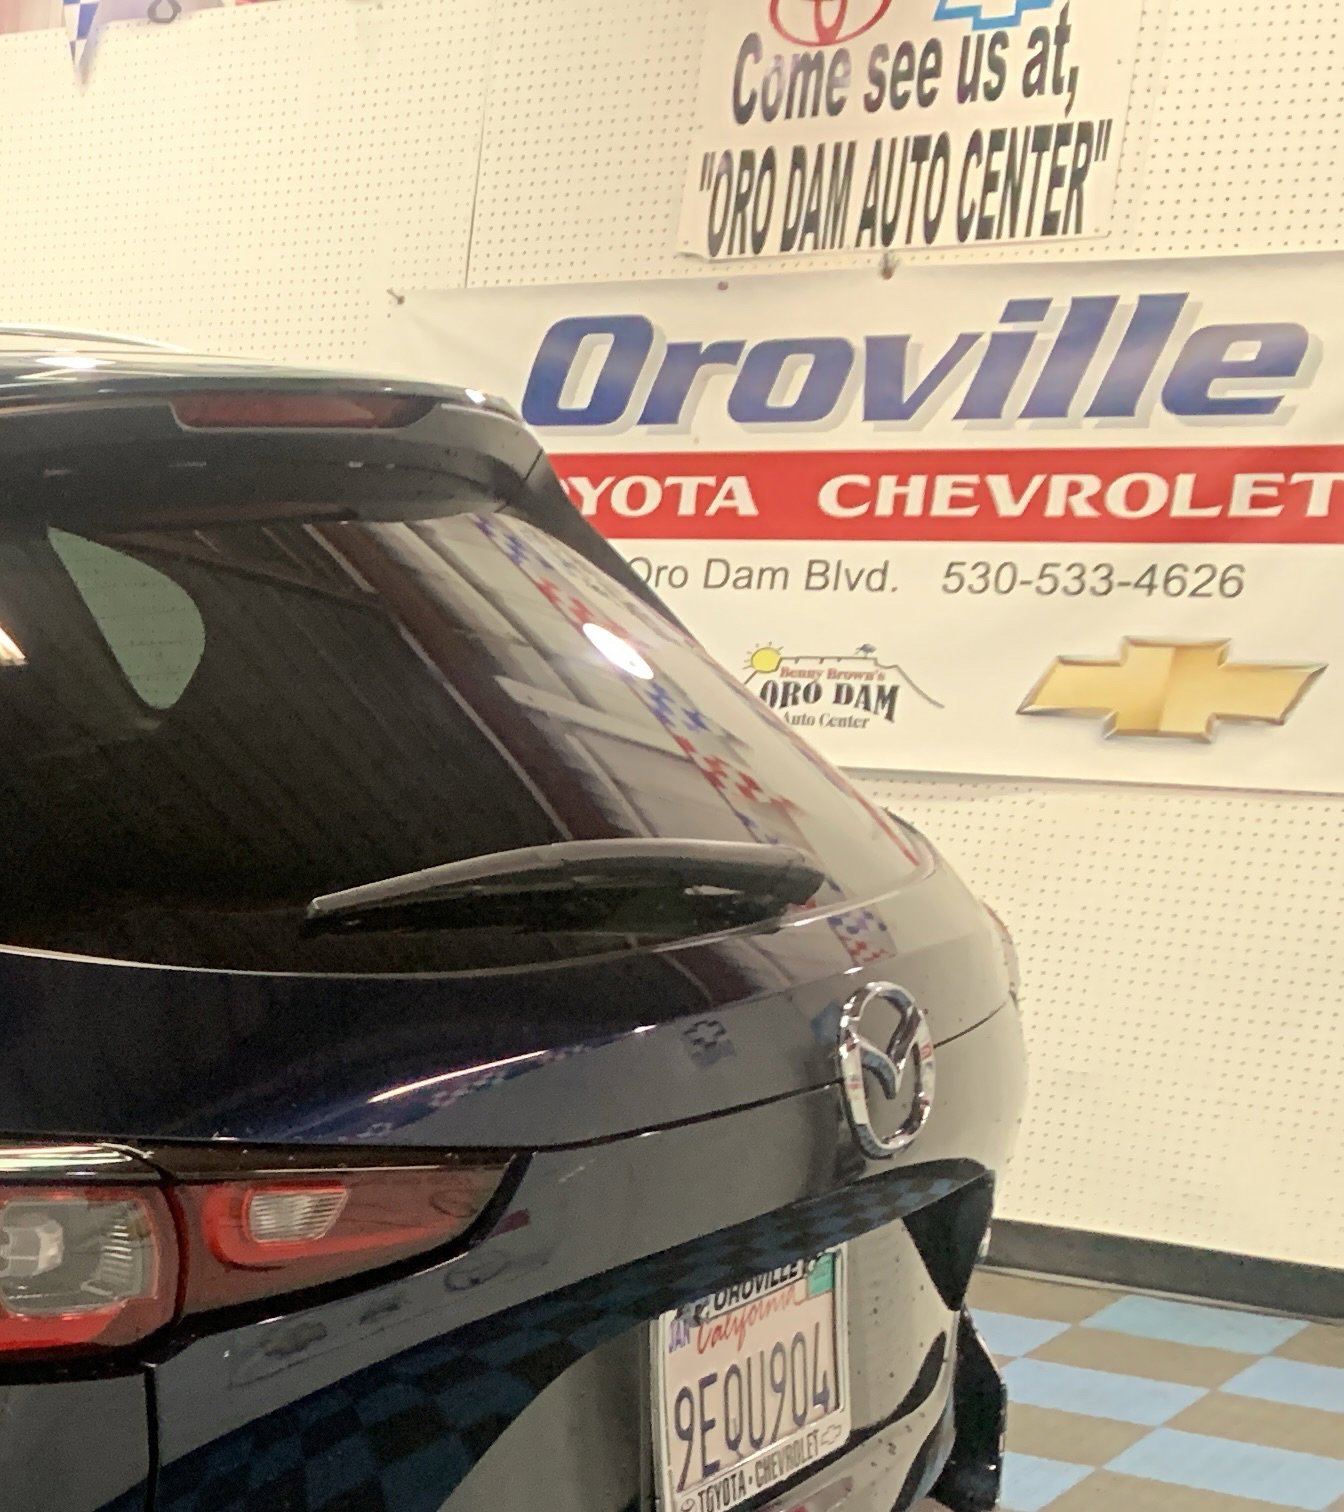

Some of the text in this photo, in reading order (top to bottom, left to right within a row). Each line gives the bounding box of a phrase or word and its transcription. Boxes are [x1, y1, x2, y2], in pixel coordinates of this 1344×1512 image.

[732, 0, 1080, 126] Come see us at,
[699, 118, 1113, 258] "ORO DAM AUTO CENTER"
[520, 292, 1310, 428] Oroville
[561, 471, 1344, 520] YOTA CHEVROLET
[702, 557, 789, 592] Dam
[803, 559, 900, 595] Blvd.
[940, 560, 1247, 600] 530-533-4626
[759, 679, 900, 724] ORO DAM
[819, 713, 870, 729] Center
[696, 1285, 810, 1355] California
[673, 1322, 830, 1493] 9EQU904
[754, 1429, 821, 1488] CHEVROLET
